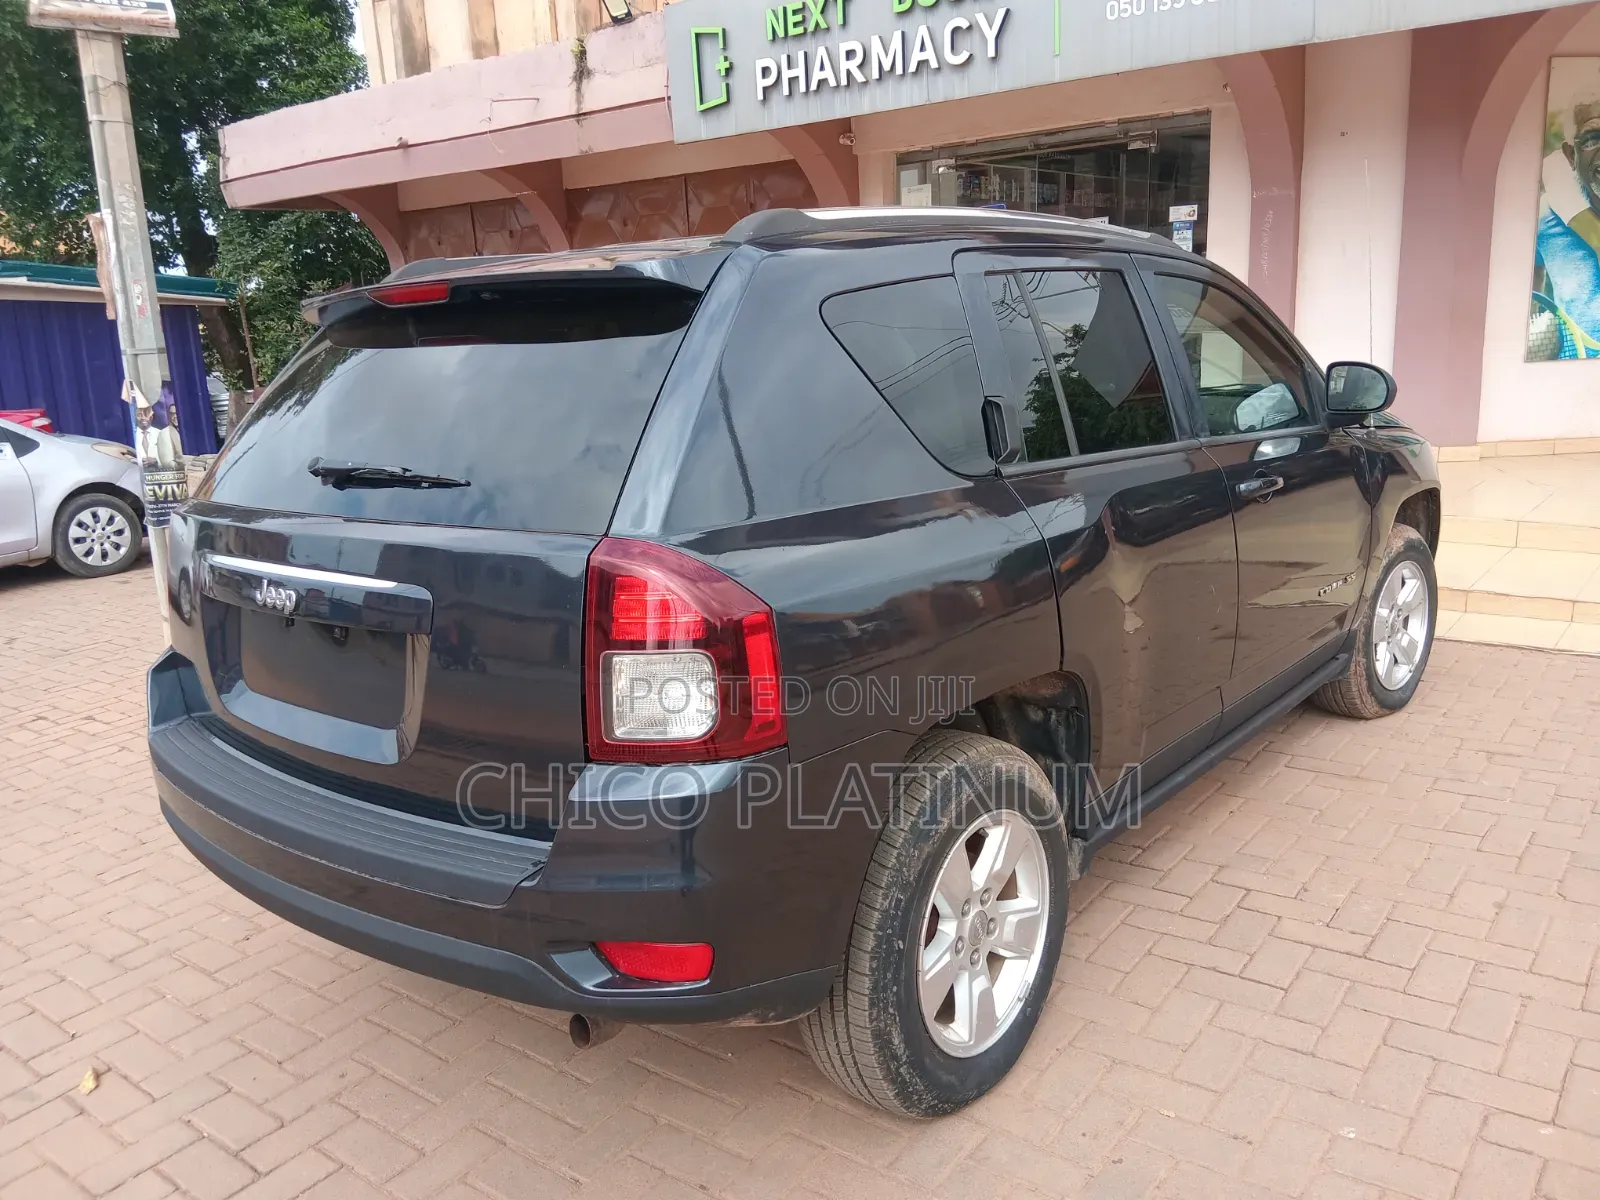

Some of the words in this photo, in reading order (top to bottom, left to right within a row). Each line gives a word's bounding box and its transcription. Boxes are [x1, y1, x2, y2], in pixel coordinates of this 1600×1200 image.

[765, 0, 846, 41] NEXT
[1105, 0, 1146, 20] 050
[755, 7, 1011, 100] PHARMACY
[255, 579, 296, 615] Jeep
